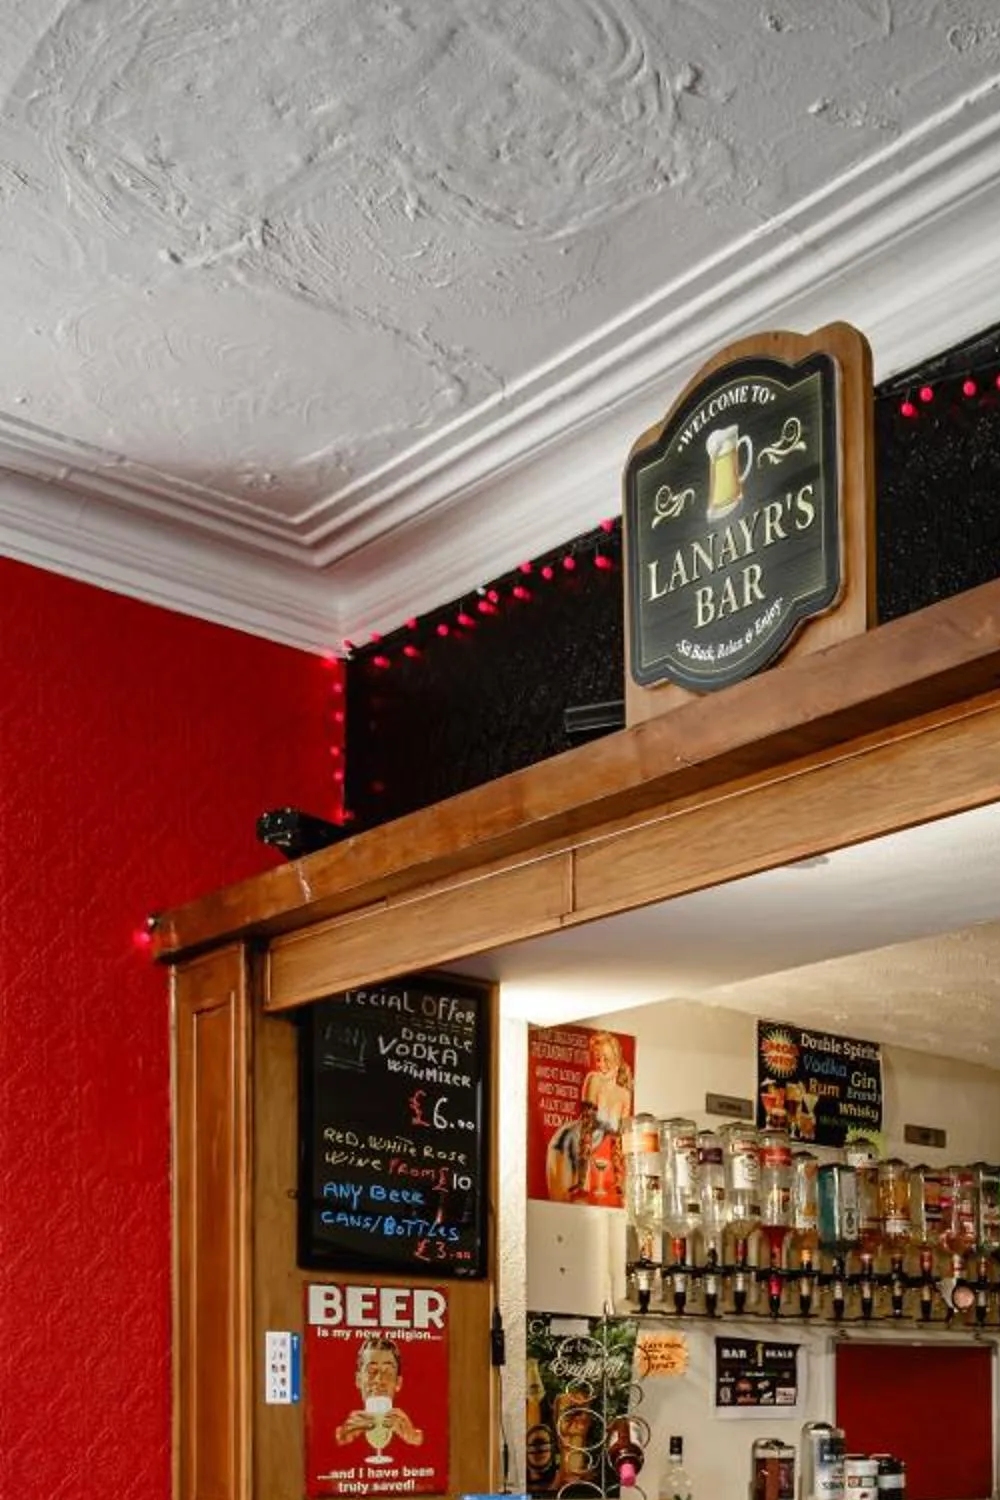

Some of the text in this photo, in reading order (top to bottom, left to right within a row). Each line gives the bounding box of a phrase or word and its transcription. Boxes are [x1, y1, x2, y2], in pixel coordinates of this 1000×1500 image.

[681, 385, 770, 445] WELCOME TO
[647, 484, 816, 602] LANAYR'S
[693, 562, 766, 630] BAR
[801, 1033, 842, 1054] Double
[803, 1053, 847, 1077] Vodka
[851, 1072, 877, 1090] Gin
[809, 1077, 840, 1098] Rum
[839, 1102, 878, 1122] Whisky
[323, 1181, 363, 1210] ANY
[309, 1285, 446, 1329] BEER
[332, 1329, 351, 1340] my
[355, 1329, 381, 1338] new
[367, 1467, 398, 1478] have
[403, 1466, 435, 1477] been
[338, 1479, 415, 1494] truly saved!
